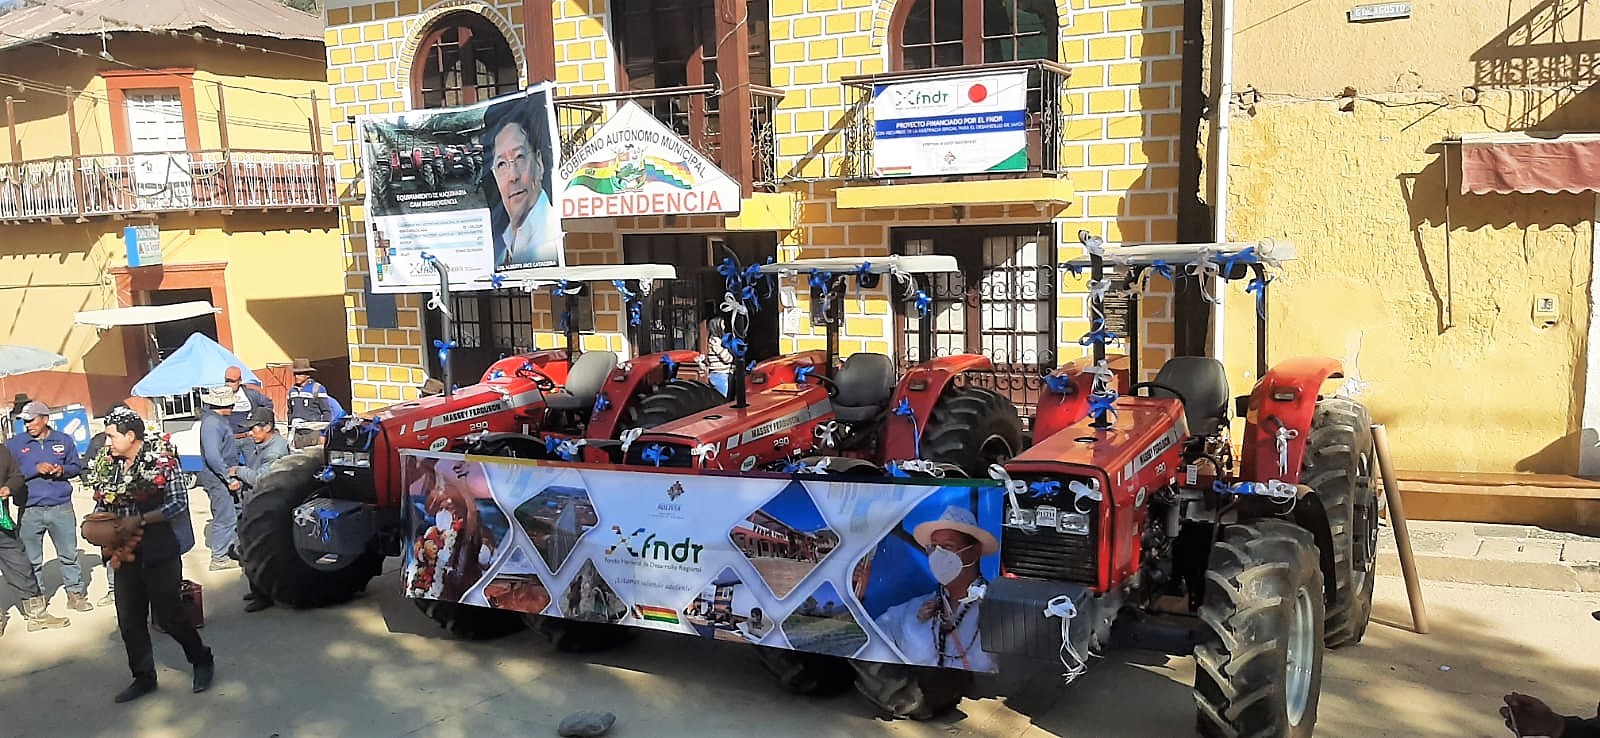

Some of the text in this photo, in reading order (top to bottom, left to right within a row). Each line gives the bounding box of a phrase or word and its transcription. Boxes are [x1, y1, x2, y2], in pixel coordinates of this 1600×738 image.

[896, 121, 926, 129] PROYECTO
[926, 118, 963, 128] FINANCIADO
[964, 116, 976, 125] POR
[560, 138, 604, 180] GOBIERNO
[660, 135, 706, 178] MUNICIPAL
[562, 191, 722, 218] DEPENDENCIA
[443, 404, 500, 423] MASSEY FERGUSON
[752, 422, 773, 438] MASSEY
[773, 436, 789, 447] 290
[642, 533, 704, 564] fndr
